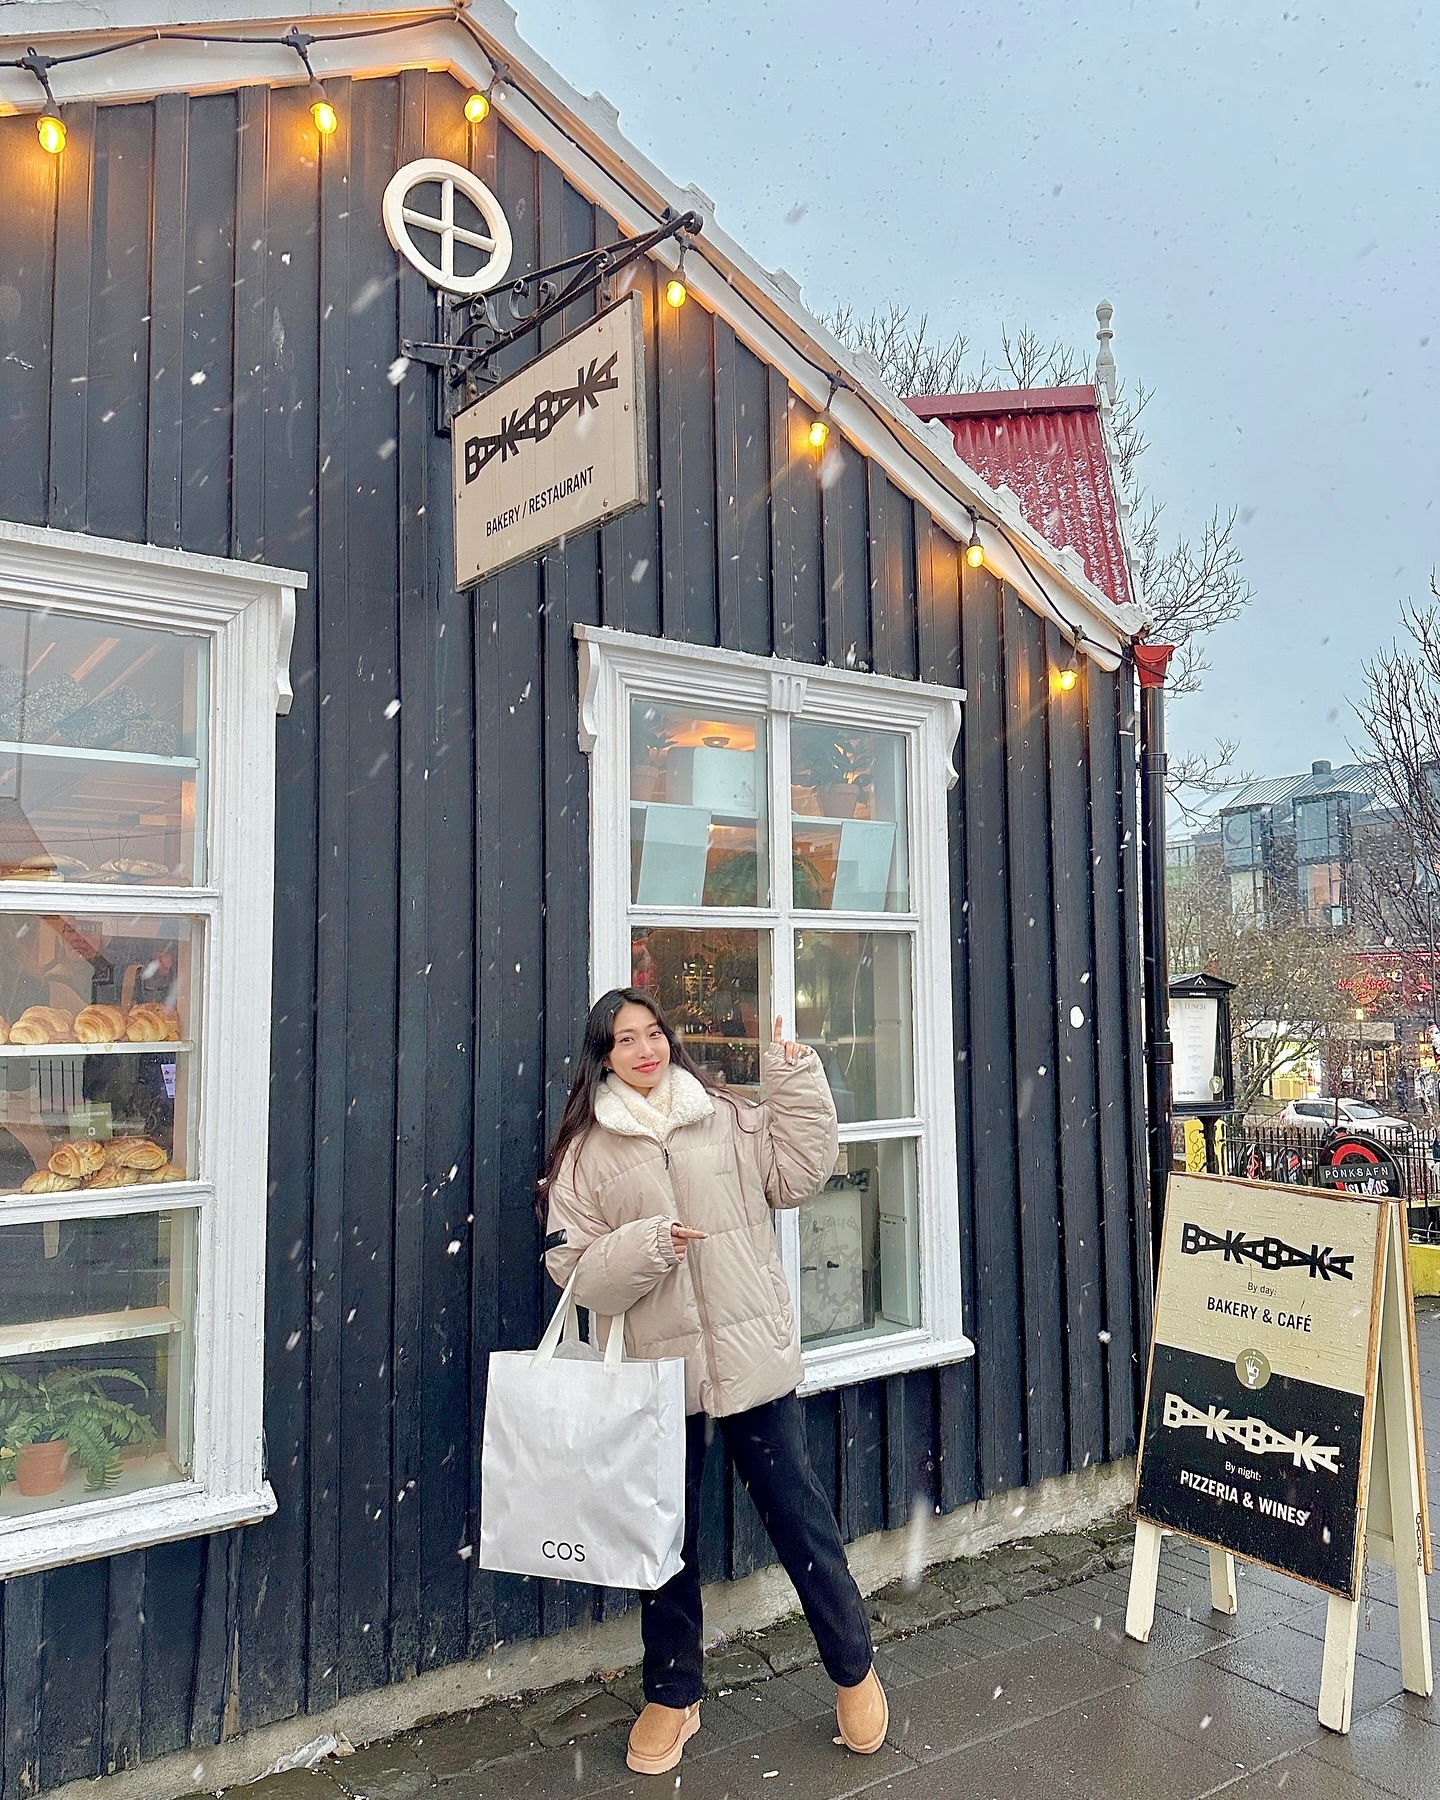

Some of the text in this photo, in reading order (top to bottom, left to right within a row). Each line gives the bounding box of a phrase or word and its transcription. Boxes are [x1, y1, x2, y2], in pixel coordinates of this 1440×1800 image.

[465, 351, 618, 485] BAKABAKA
[486, 505, 520, 537] BAKERY
[529, 466, 594, 515] RESTAURANT
[1325, 1166, 1389, 1179] PÖNKSAFN
[1344, 1179, 1389, 1196] ÍSLADS
[1181, 1222, 1355, 1281] BAKABAKA
[1247, 1282, 1277, 1297] By day:
[1207, 1296, 1312, 1333] BAKERY & CAFÉ
[1162, 1392, 1340, 1475] BAKABAKA
[1225, 1460, 1262, 1482] By night:
[1180, 1469, 1307, 1527] PIZZERIA & WINES
[542, 1540, 585, 1562] COS
